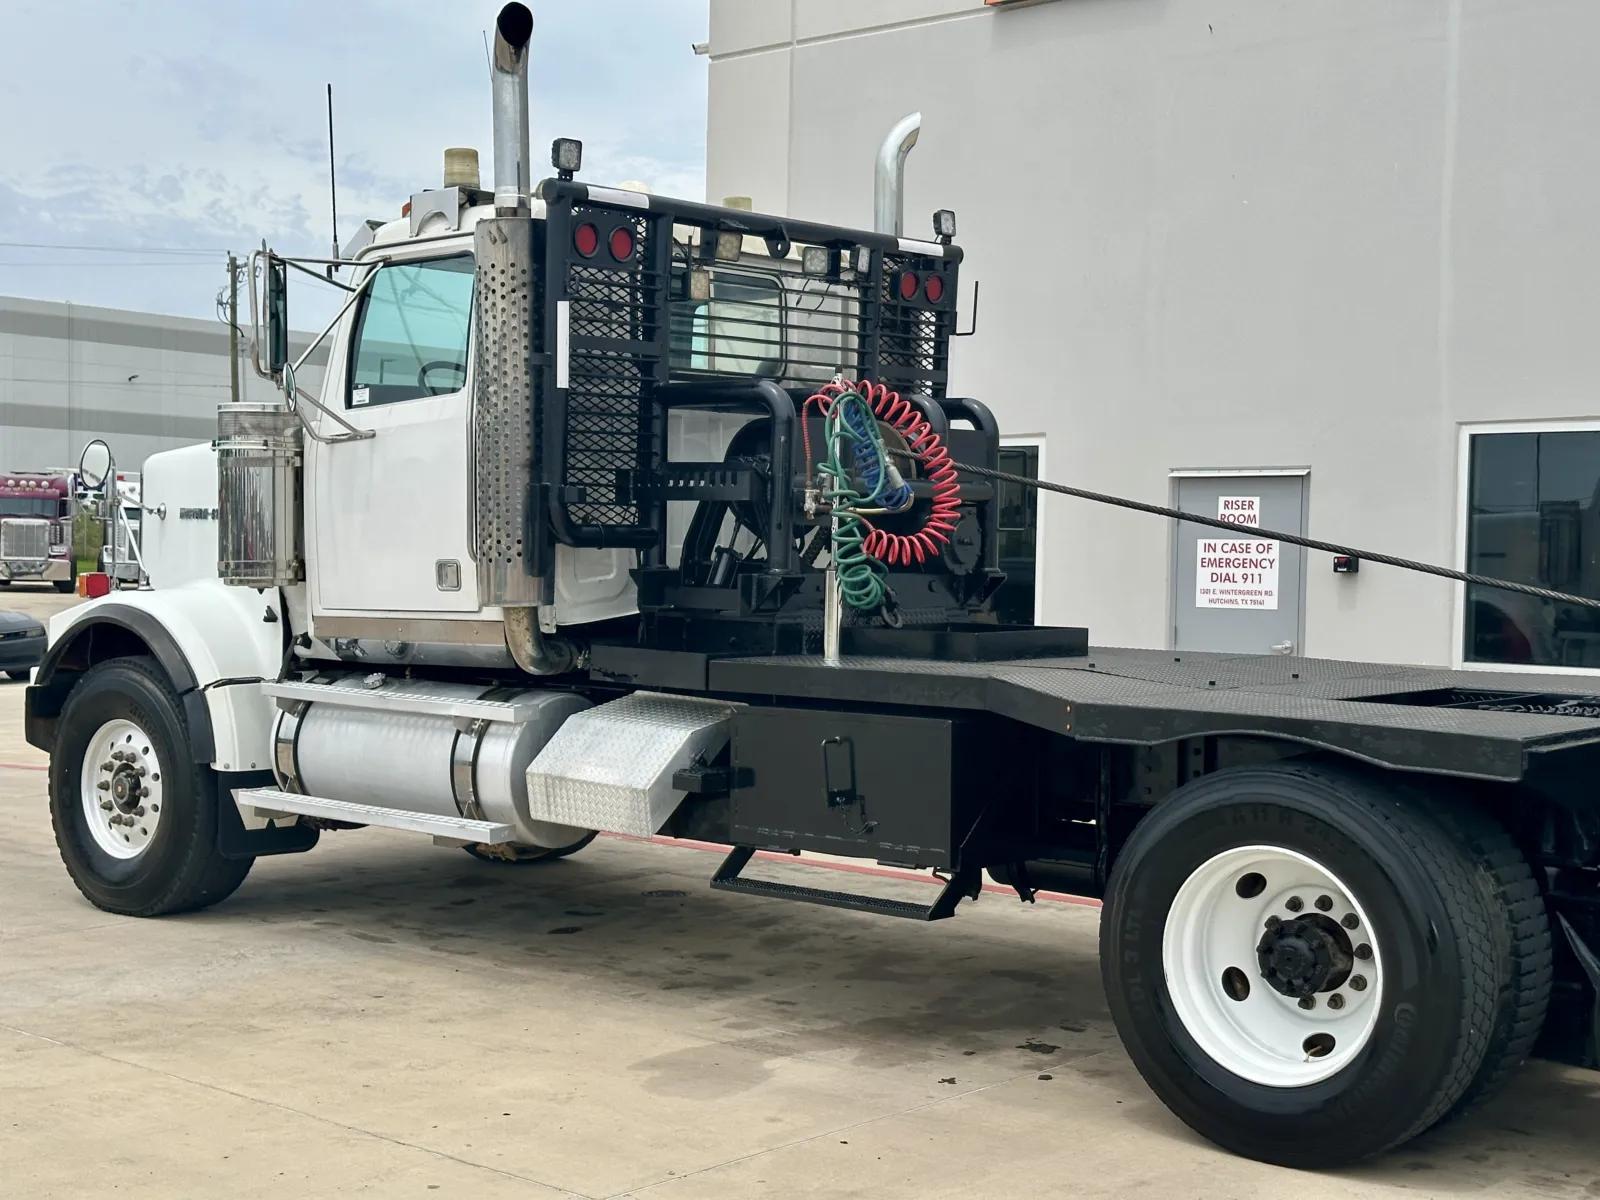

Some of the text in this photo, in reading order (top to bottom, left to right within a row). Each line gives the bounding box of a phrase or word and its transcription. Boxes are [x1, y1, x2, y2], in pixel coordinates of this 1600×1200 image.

[1224, 500, 1254, 510] RISER
[1220, 514, 1257, 524] ROOM
[1203, 542, 1273, 554] IN CASE OF
[1200, 557, 1275, 569] EMERGENCY
[1210, 572, 1262, 584] DIAL 911
[1219, 589, 1263, 597] WINTERGREEN
